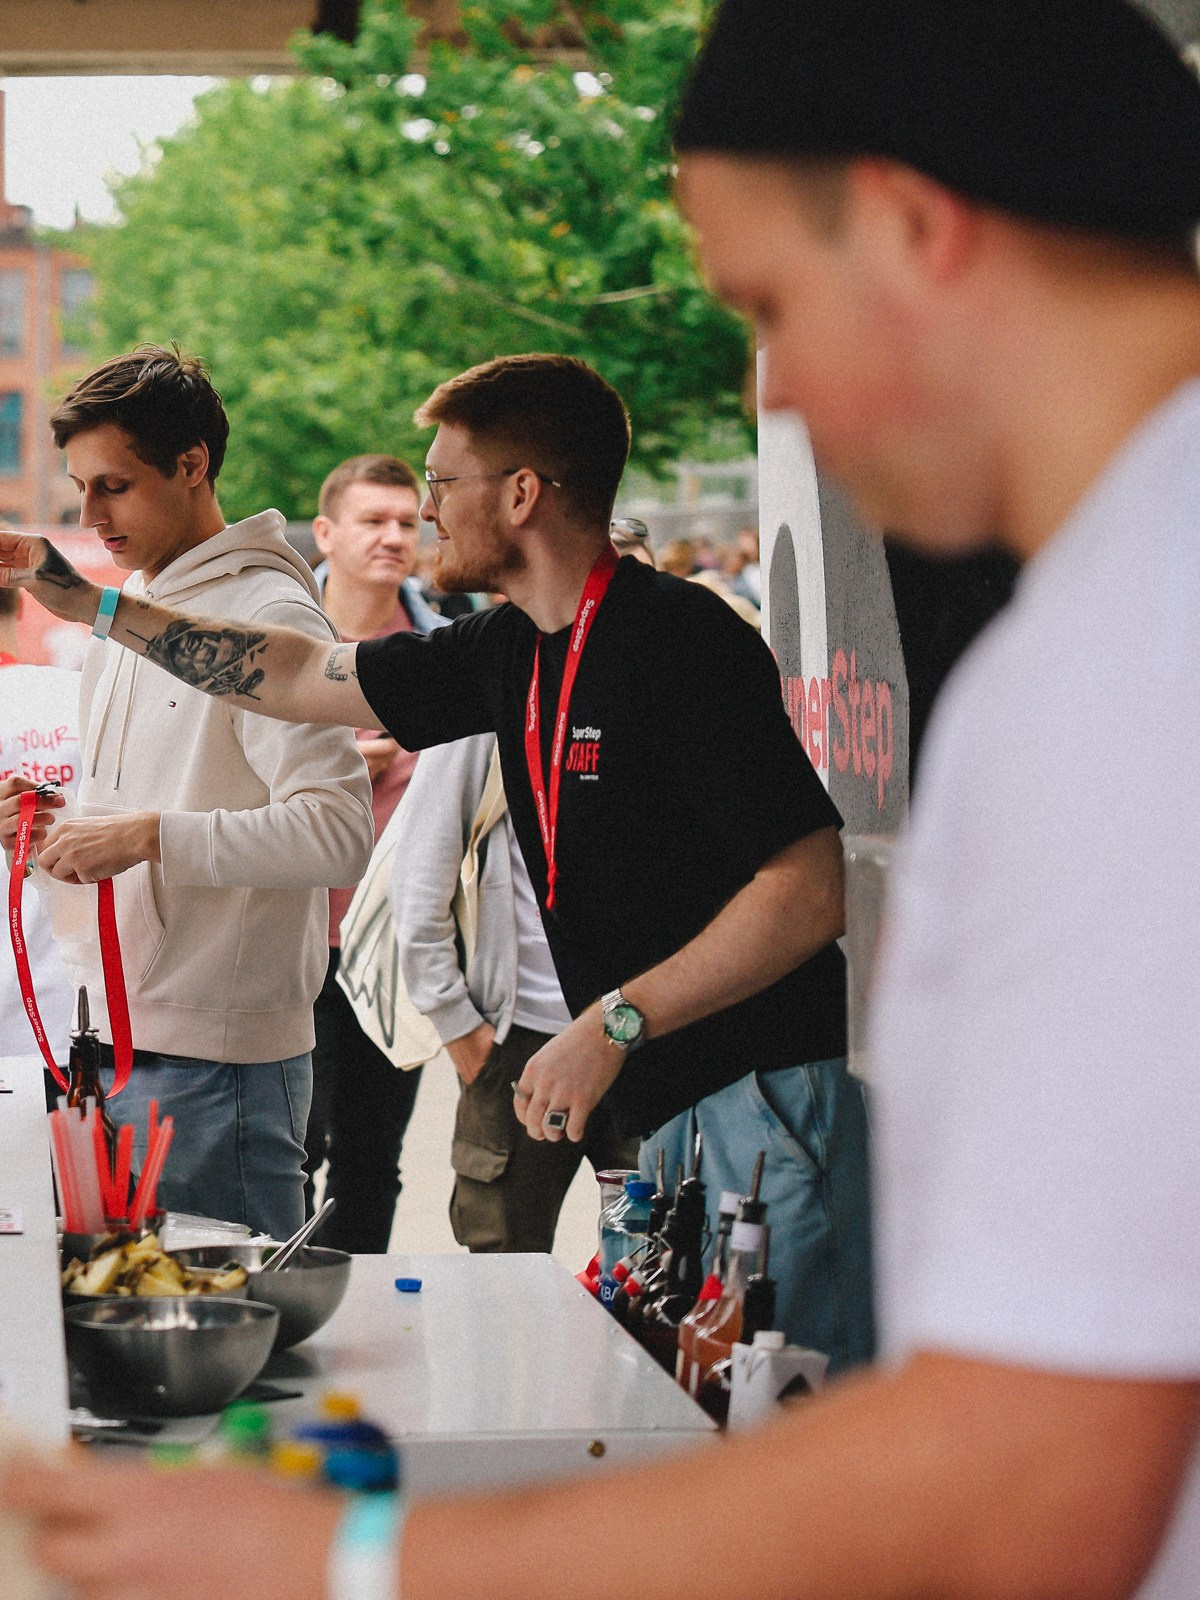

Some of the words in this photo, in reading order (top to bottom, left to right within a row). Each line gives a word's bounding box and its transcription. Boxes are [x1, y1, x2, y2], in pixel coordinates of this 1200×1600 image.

[573, 598, 595, 652] SuperStep
[17, 724, 80, 751] YOUR
[554, 712, 566, 766] SuperStep
[565, 742, 601, 772] STAFF
[16, 821, 28, 866] SuperStep
[11, 907, 23, 954] SuperStep
[26, 997, 45, 1043] SuperStep
